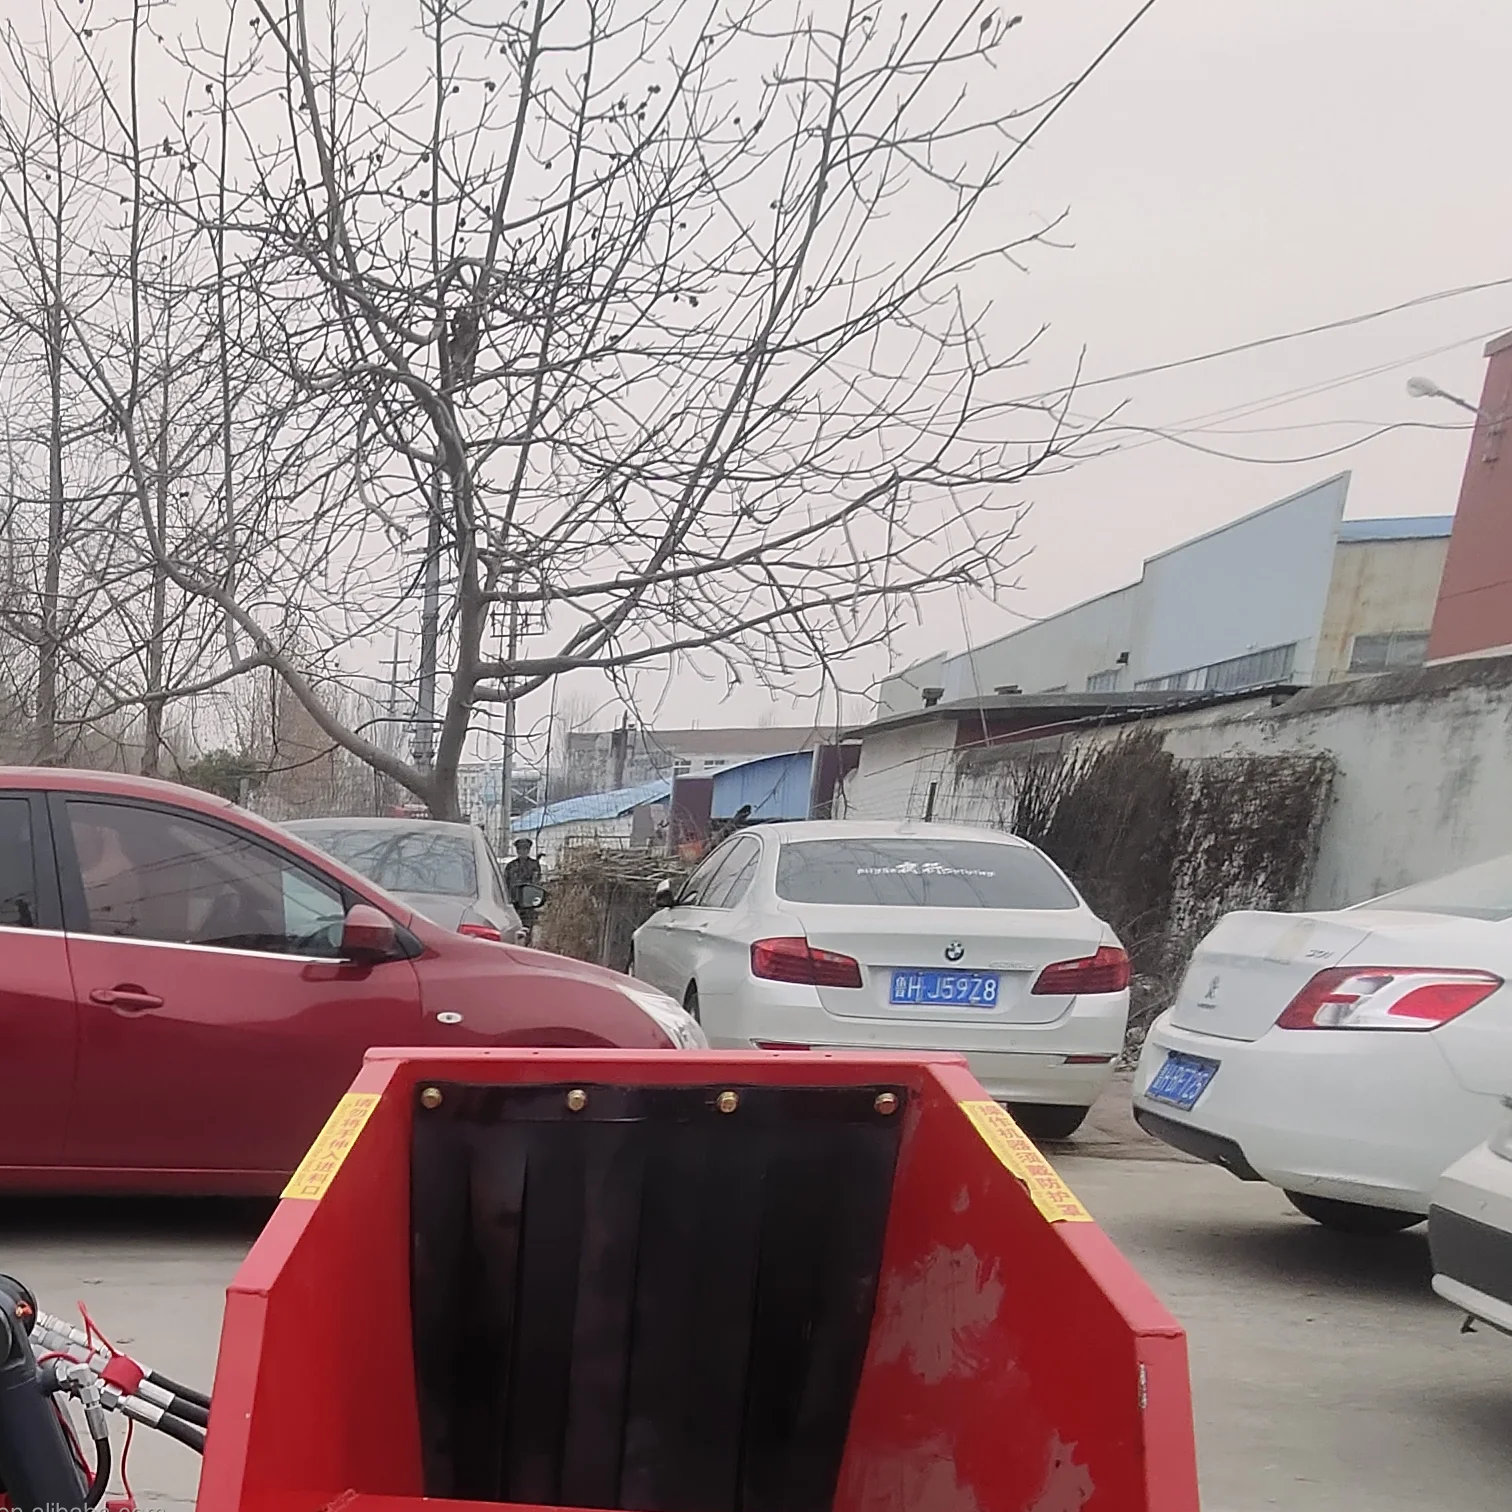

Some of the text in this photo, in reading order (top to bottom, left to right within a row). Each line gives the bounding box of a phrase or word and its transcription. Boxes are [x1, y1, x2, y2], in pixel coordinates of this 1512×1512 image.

[300, 1098, 374, 1196] 请勿将手伸入进料口
